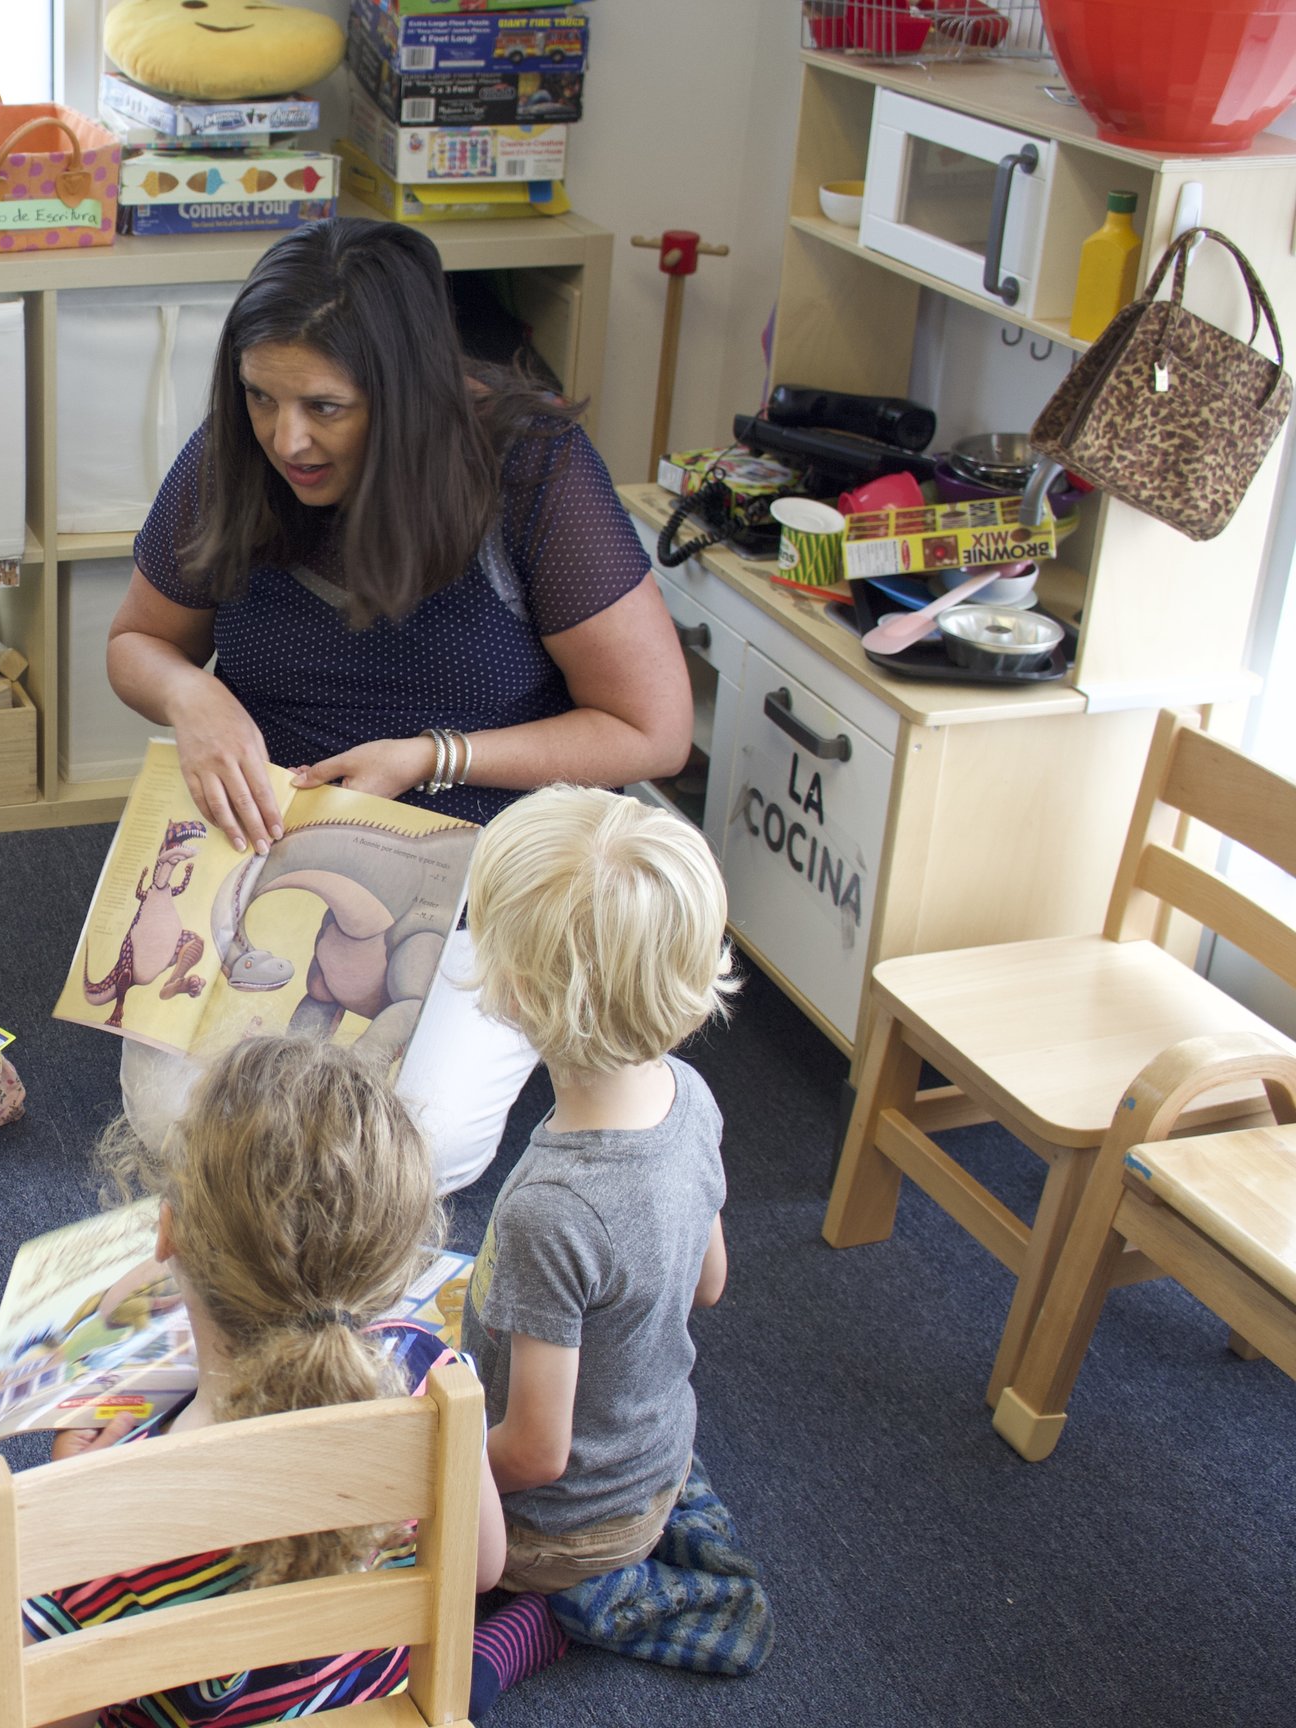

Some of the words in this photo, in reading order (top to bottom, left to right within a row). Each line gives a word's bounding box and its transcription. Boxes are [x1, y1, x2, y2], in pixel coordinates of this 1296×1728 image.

[428, 20, 448, 28] Large
[449, 19, 466, 27] Floor
[498, 18, 527, 28] GIANT
[529, 18, 552, 27] FIRE
[554, 17, 586, 27] TRUCK
[420, 34, 427, 42] 4
[428, 34, 450, 42] Foot
[450, 34, 477, 43] Long!
[12, 207, 30, 223] de
[35, 207, 99, 225] Escritura
[178, 201, 250, 219] Connect
[253, 200, 293, 215] Four
[972, 528, 1011, 549] MIX
[963, 542, 1049, 564] BROWNIE
[789, 752, 824, 826] LA
[743, 787, 861, 928] COCINA
